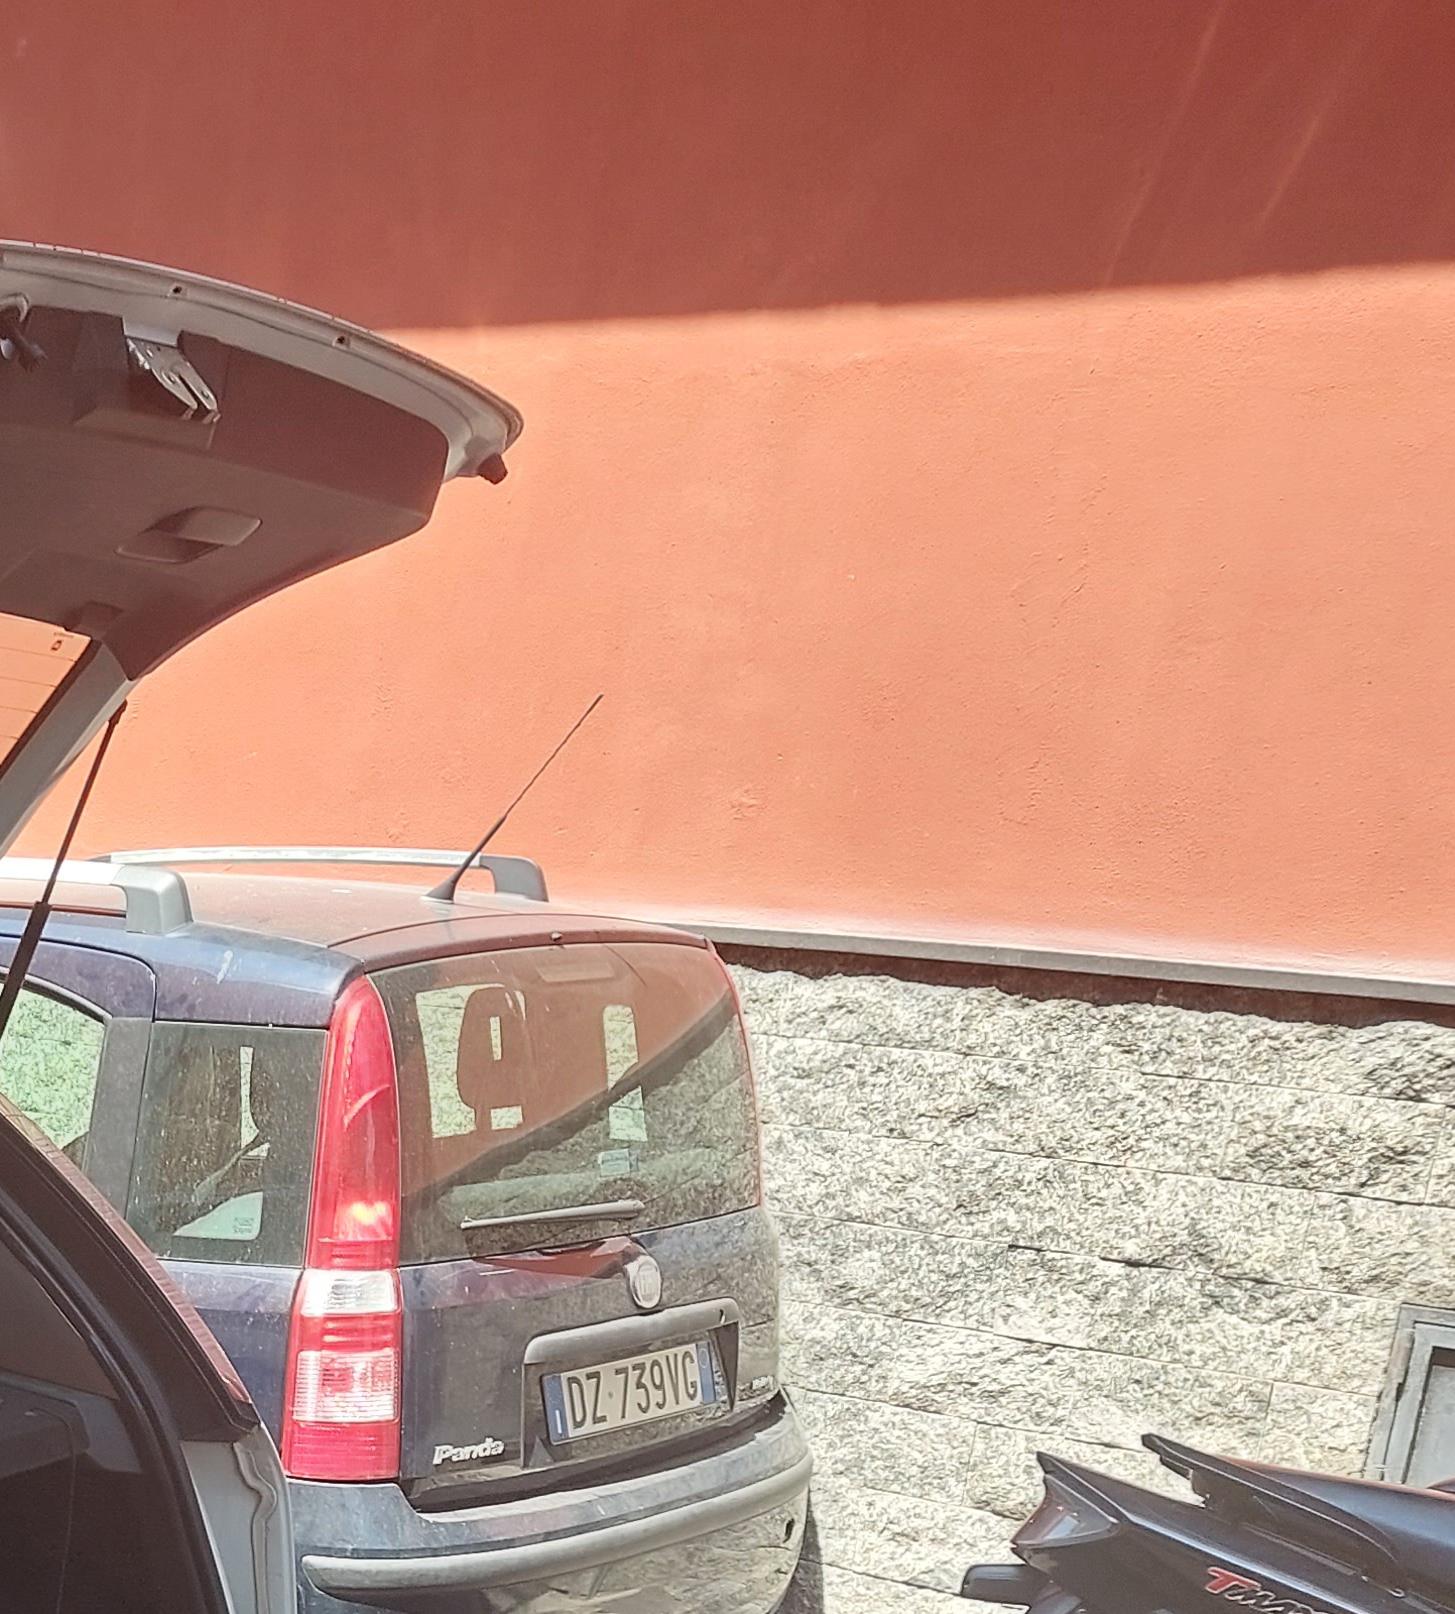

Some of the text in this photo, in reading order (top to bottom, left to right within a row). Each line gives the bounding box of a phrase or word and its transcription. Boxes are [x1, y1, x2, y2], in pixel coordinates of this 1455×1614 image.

[567, 1371, 607, 1430] DZ
[614, 1350, 698, 1421] 739VG
[432, 1437, 505, 1465] Panda
